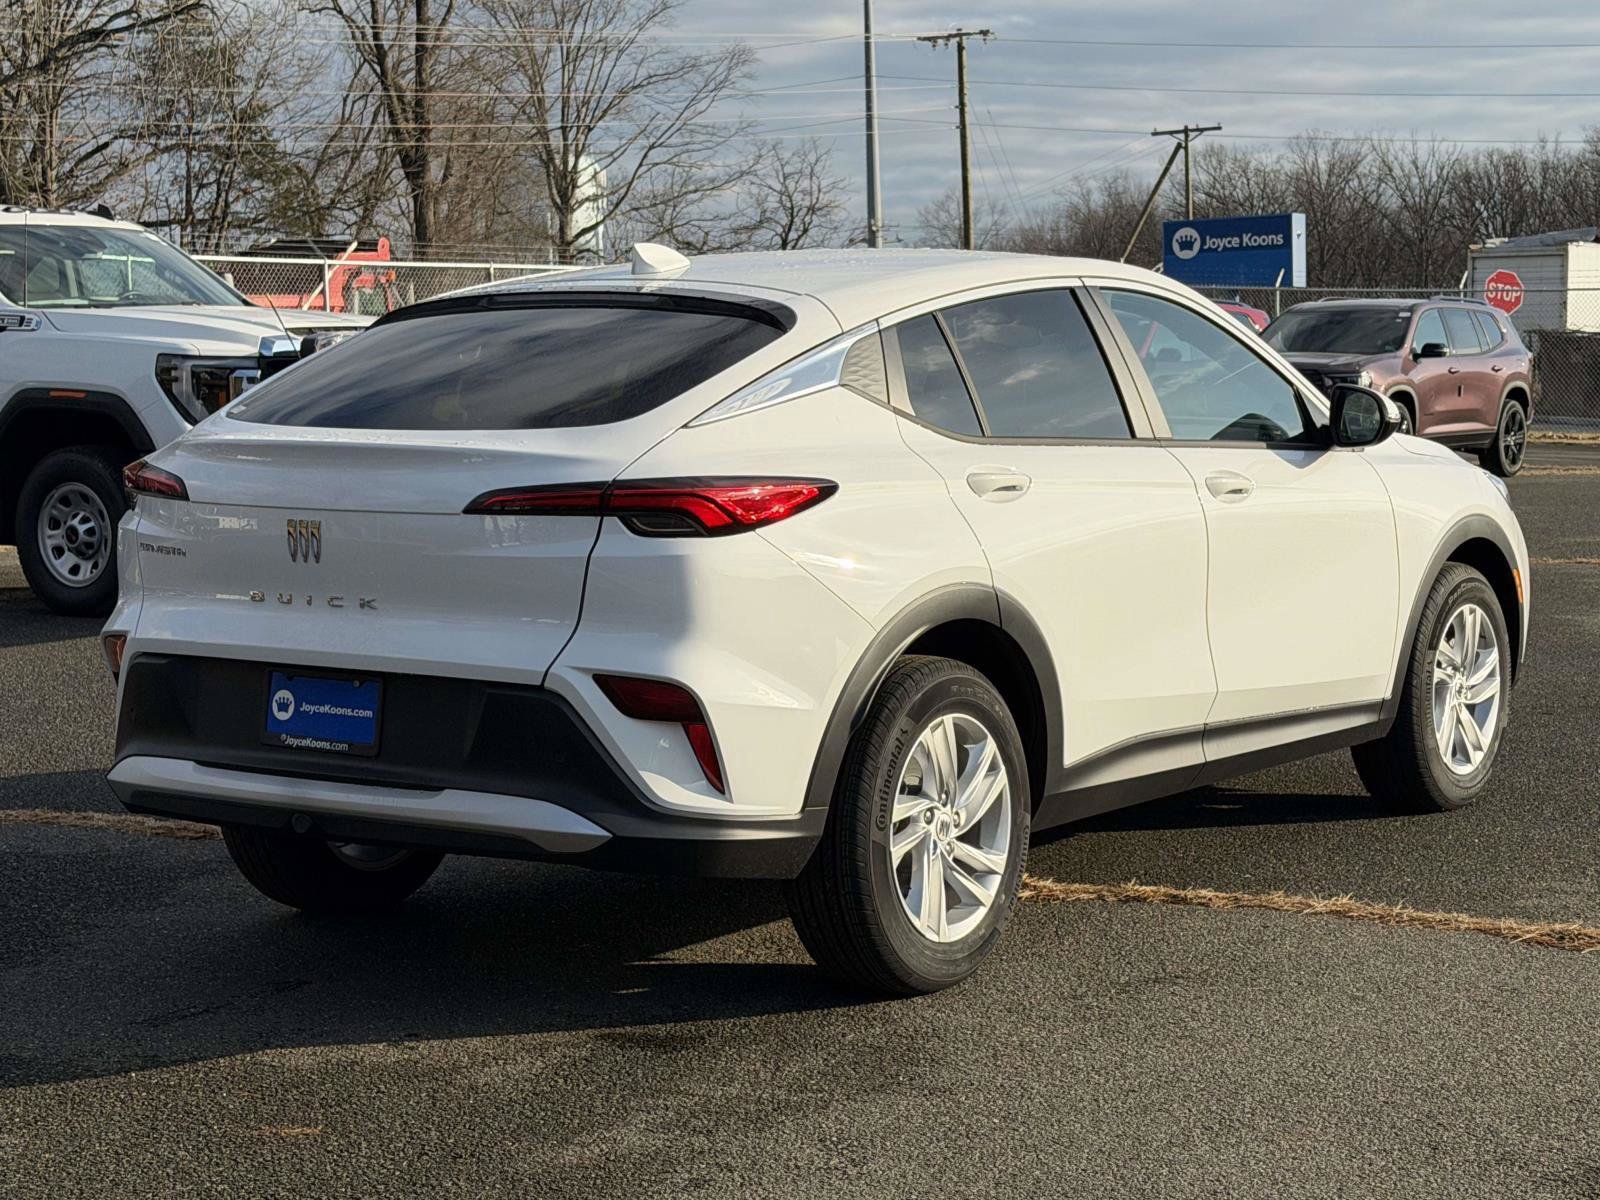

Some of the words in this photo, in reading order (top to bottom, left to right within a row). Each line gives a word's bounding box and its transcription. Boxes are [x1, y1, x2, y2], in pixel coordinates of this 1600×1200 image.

[1203, 235, 1240, 252] Joyce
[1242, 232, 1284, 248] Koons
[1487, 282, 1521, 303] STOP
[249, 590, 378, 610] BUICK
[299, 701, 373, 718] JoyceKoons.com
[875, 737, 905, 832] Continental
